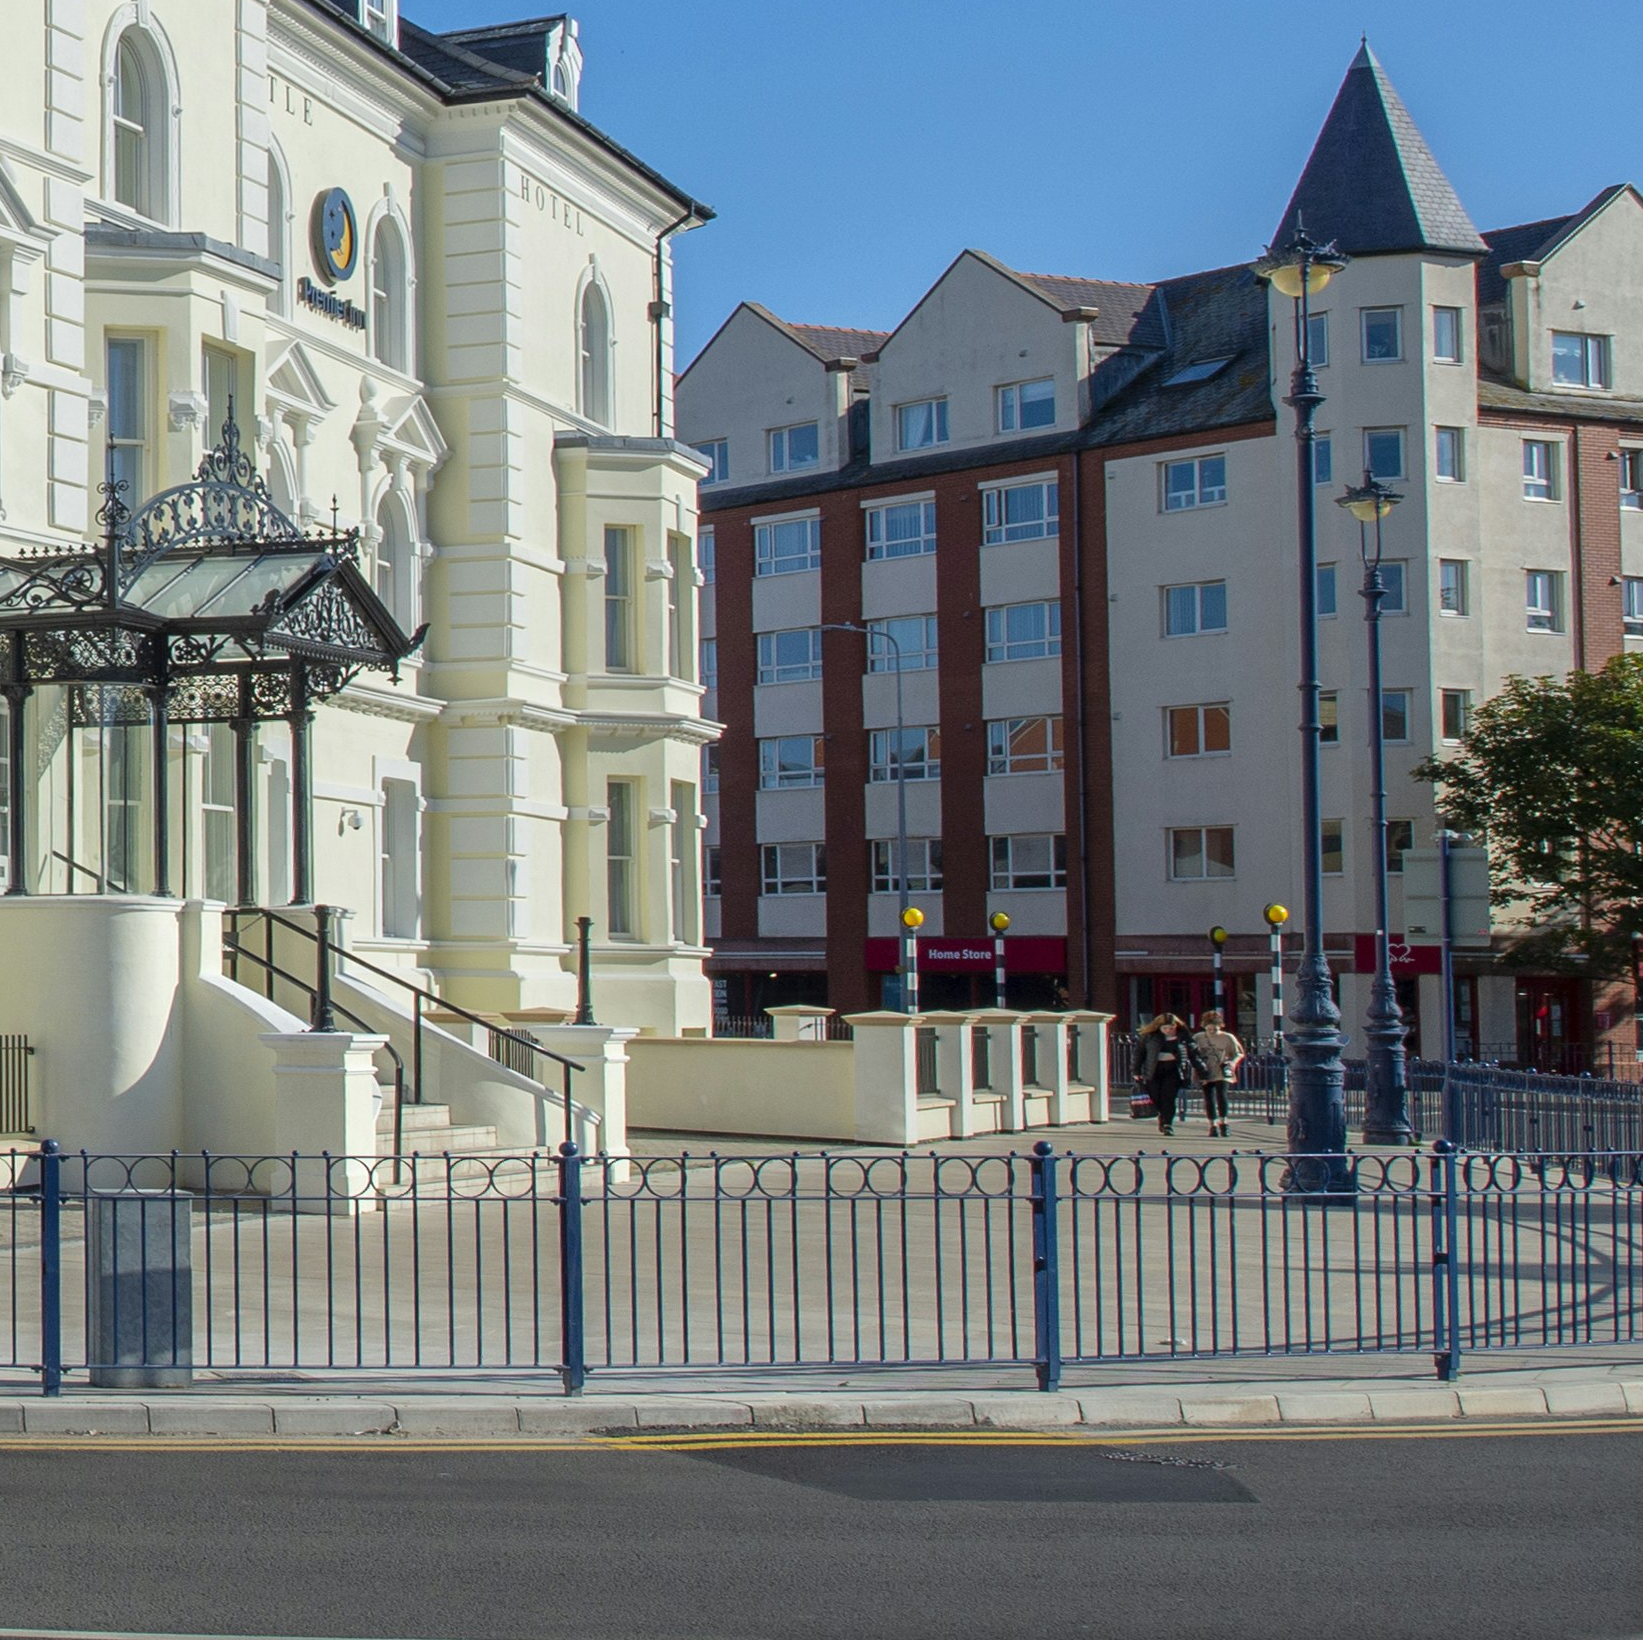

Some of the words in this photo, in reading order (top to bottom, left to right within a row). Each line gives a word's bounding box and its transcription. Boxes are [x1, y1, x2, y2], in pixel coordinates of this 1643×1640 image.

[521, 175, 584, 237] HOTEL
[297, 277, 346, 320] Premier
[343, 299, 366, 330] Inn
[929, 949, 960, 960] Home
[962, 949, 992, 960] Store
